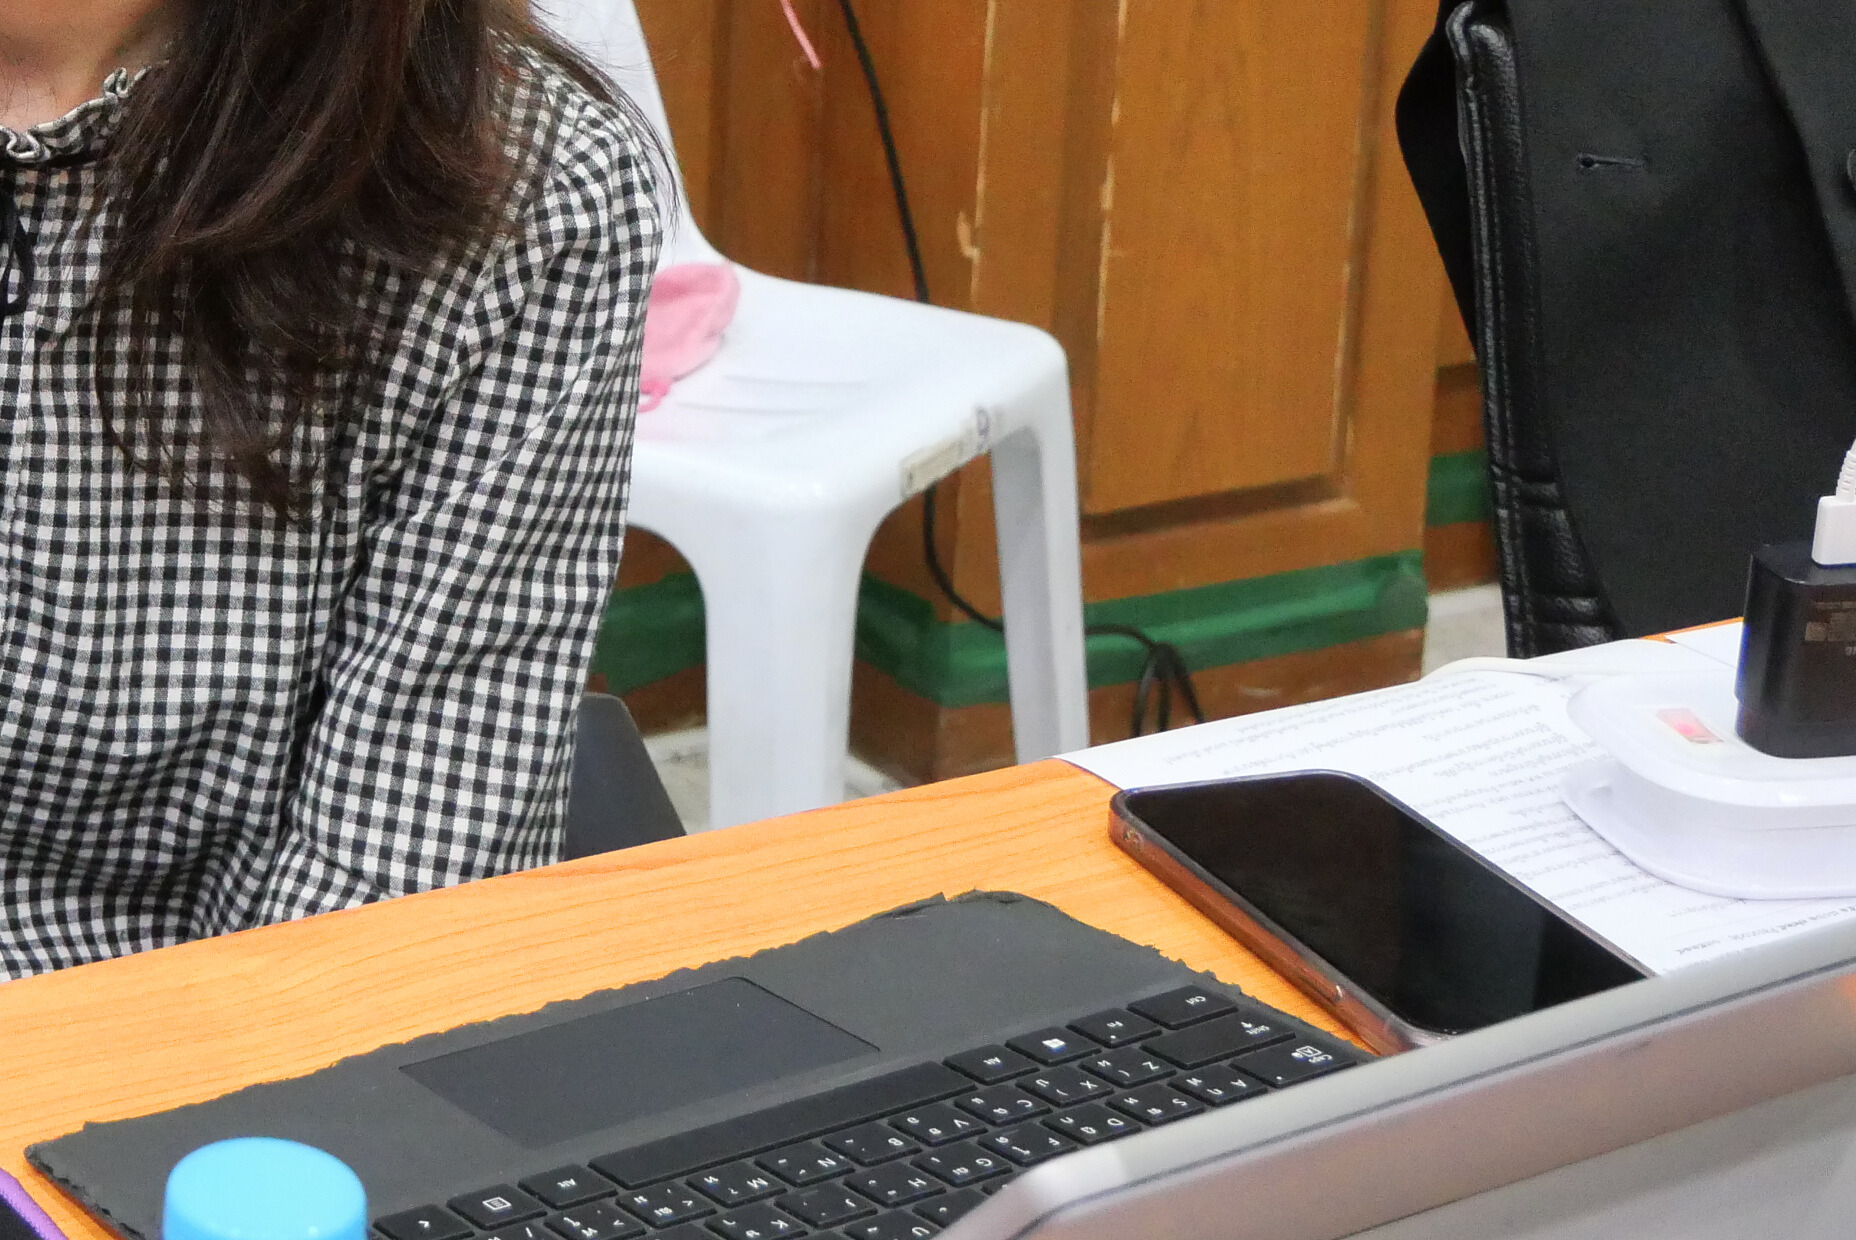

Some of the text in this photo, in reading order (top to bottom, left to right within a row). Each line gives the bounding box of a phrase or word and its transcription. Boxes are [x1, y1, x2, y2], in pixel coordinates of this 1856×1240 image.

[1185, 995, 1207, 1006] Ctrl
[1244, 1023, 1271, 1036] Shift
[982, 1056, 1002, 1066] Alt
[556, 1178, 577, 1190] Alt
[746, 1177, 769, 1190] M
[907, 1177, 928, 1189] H
